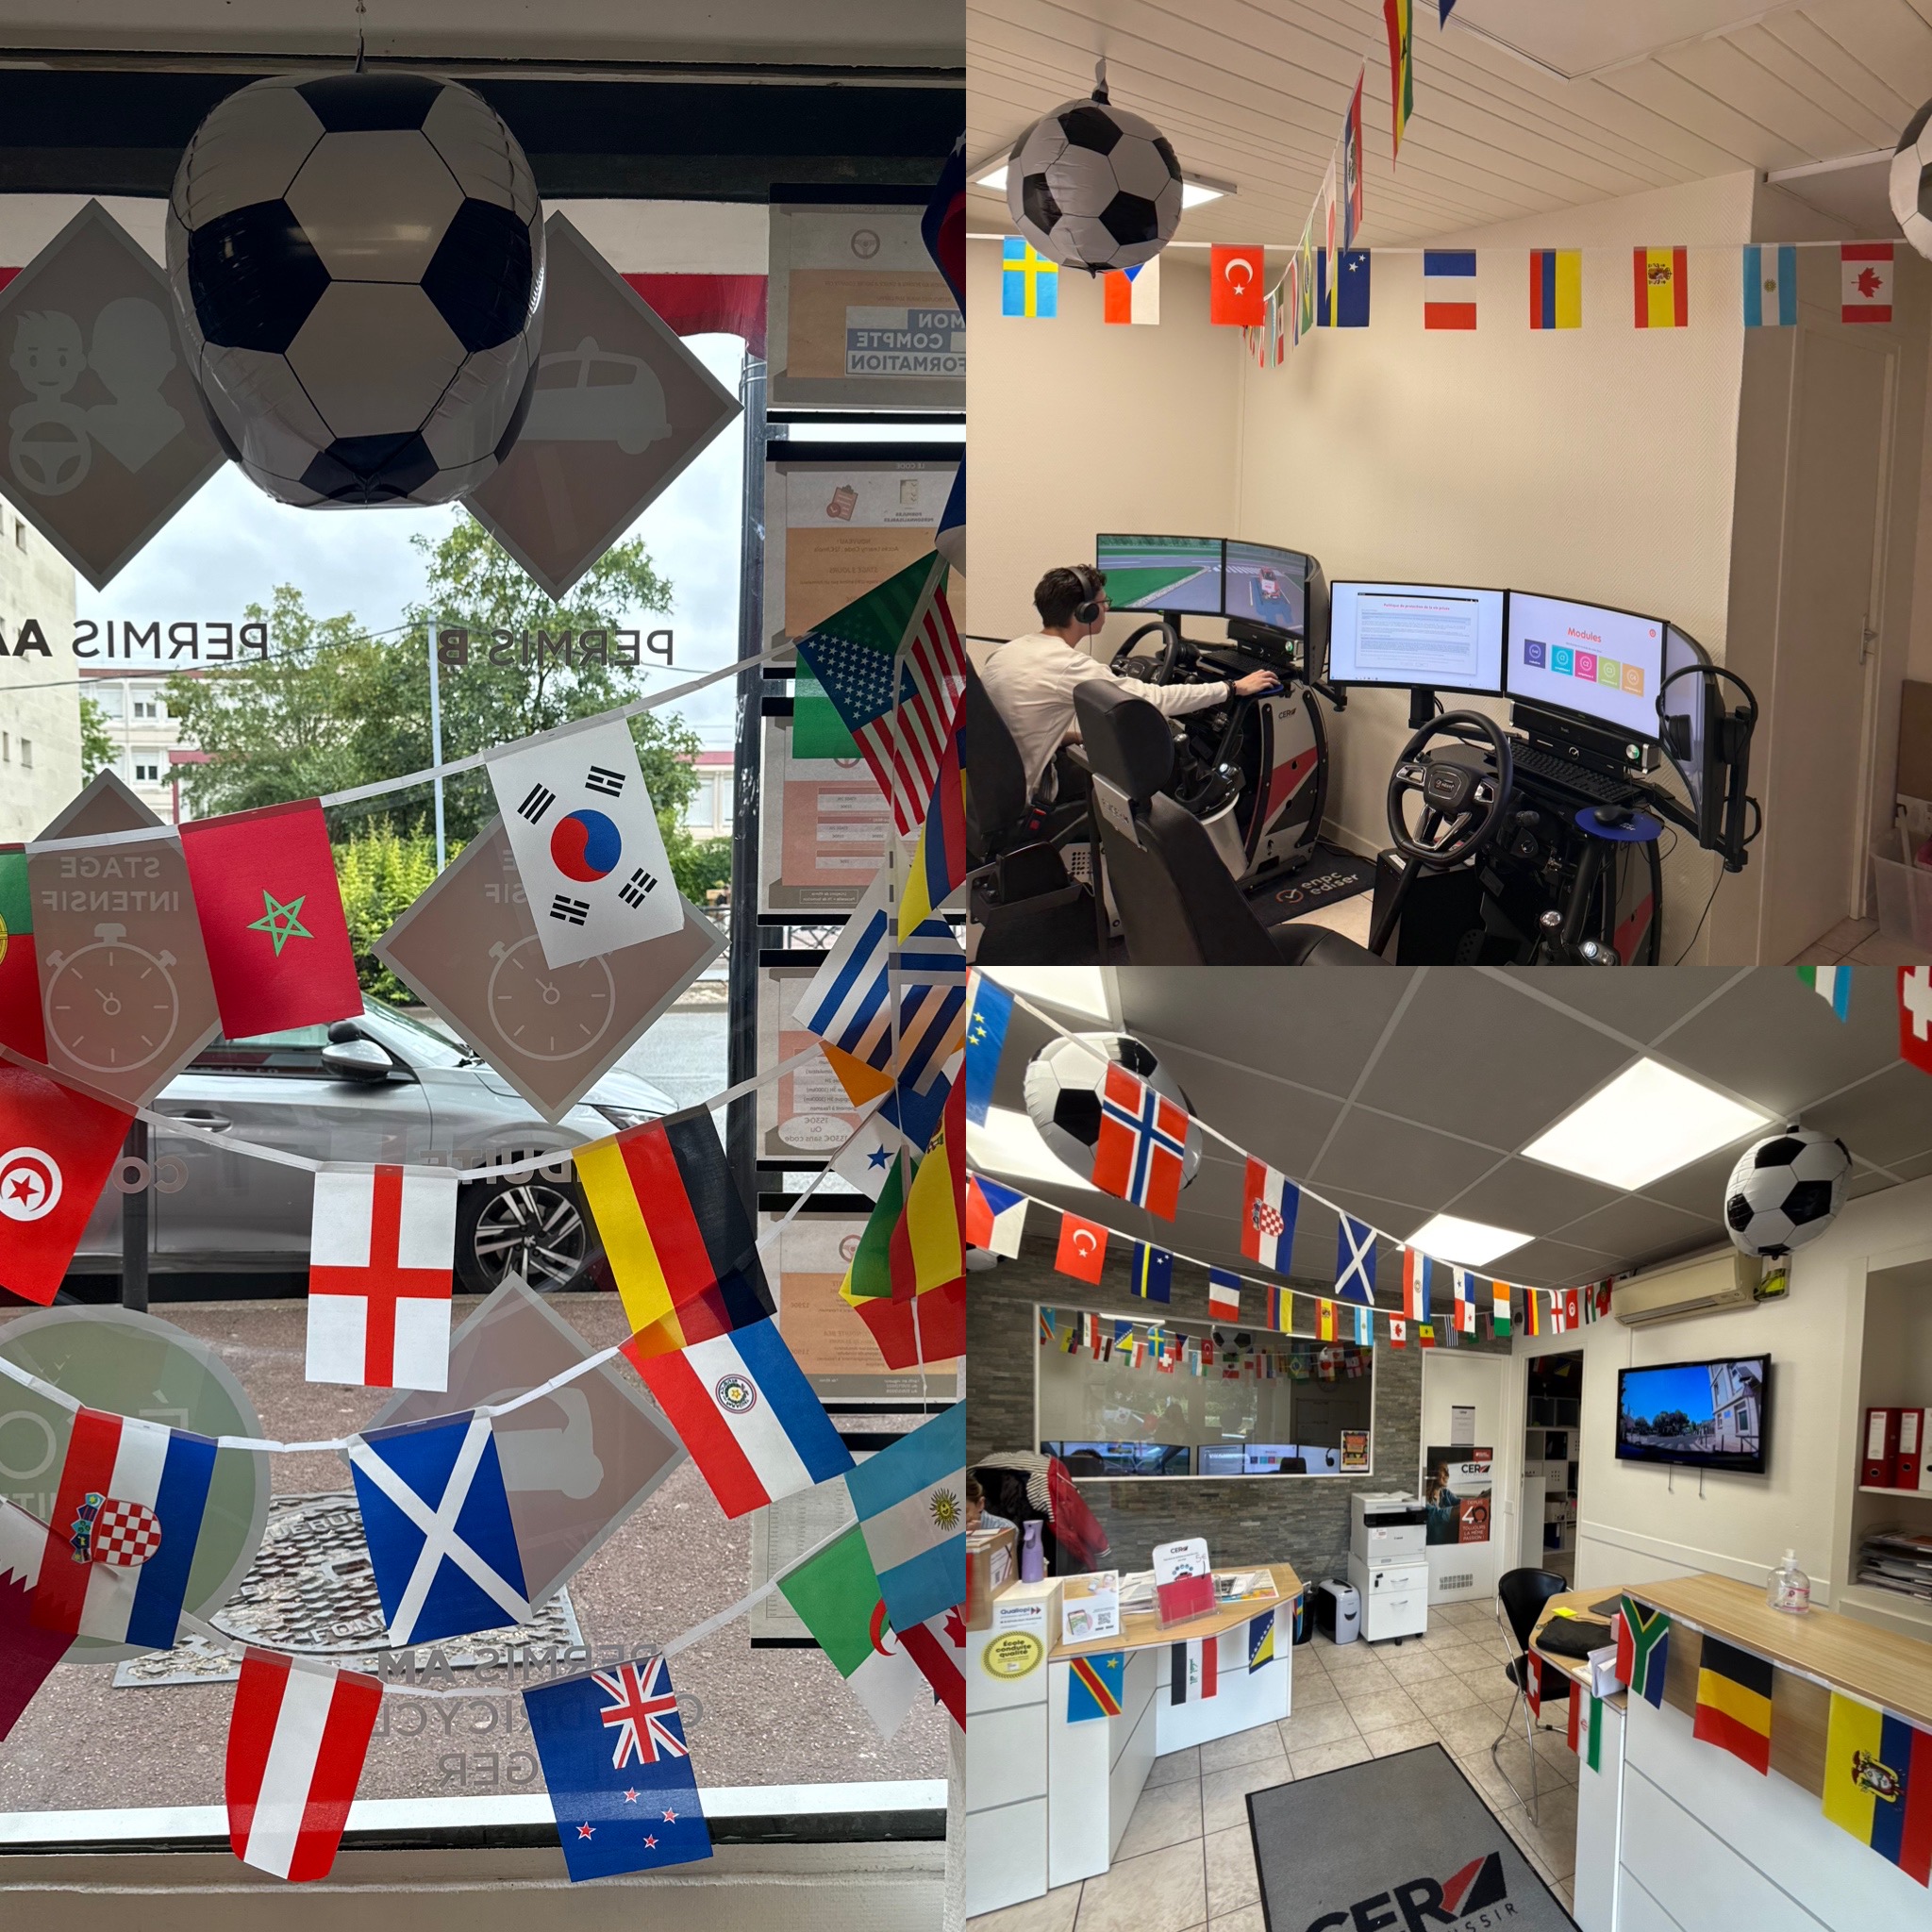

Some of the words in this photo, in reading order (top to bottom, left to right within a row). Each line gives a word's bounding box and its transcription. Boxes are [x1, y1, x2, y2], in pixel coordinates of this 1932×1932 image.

[1567, 626, 1602, 643] Modules
[1301, 872, 1342, 890] enpc
[1309, 874, 1359, 895] ediser
[1461, 1464, 1481, 1474] CER
[1461, 1506, 1488, 1524] 40
[1195, 1553, 1208, 1563] 5€
[1000, 1607, 1030, 1615] Qualiopi
[995, 1644, 1032, 1653] conduite
[999, 1649, 1028, 1658] qualité
[1447, 1903, 1519, 1932] SSIR
